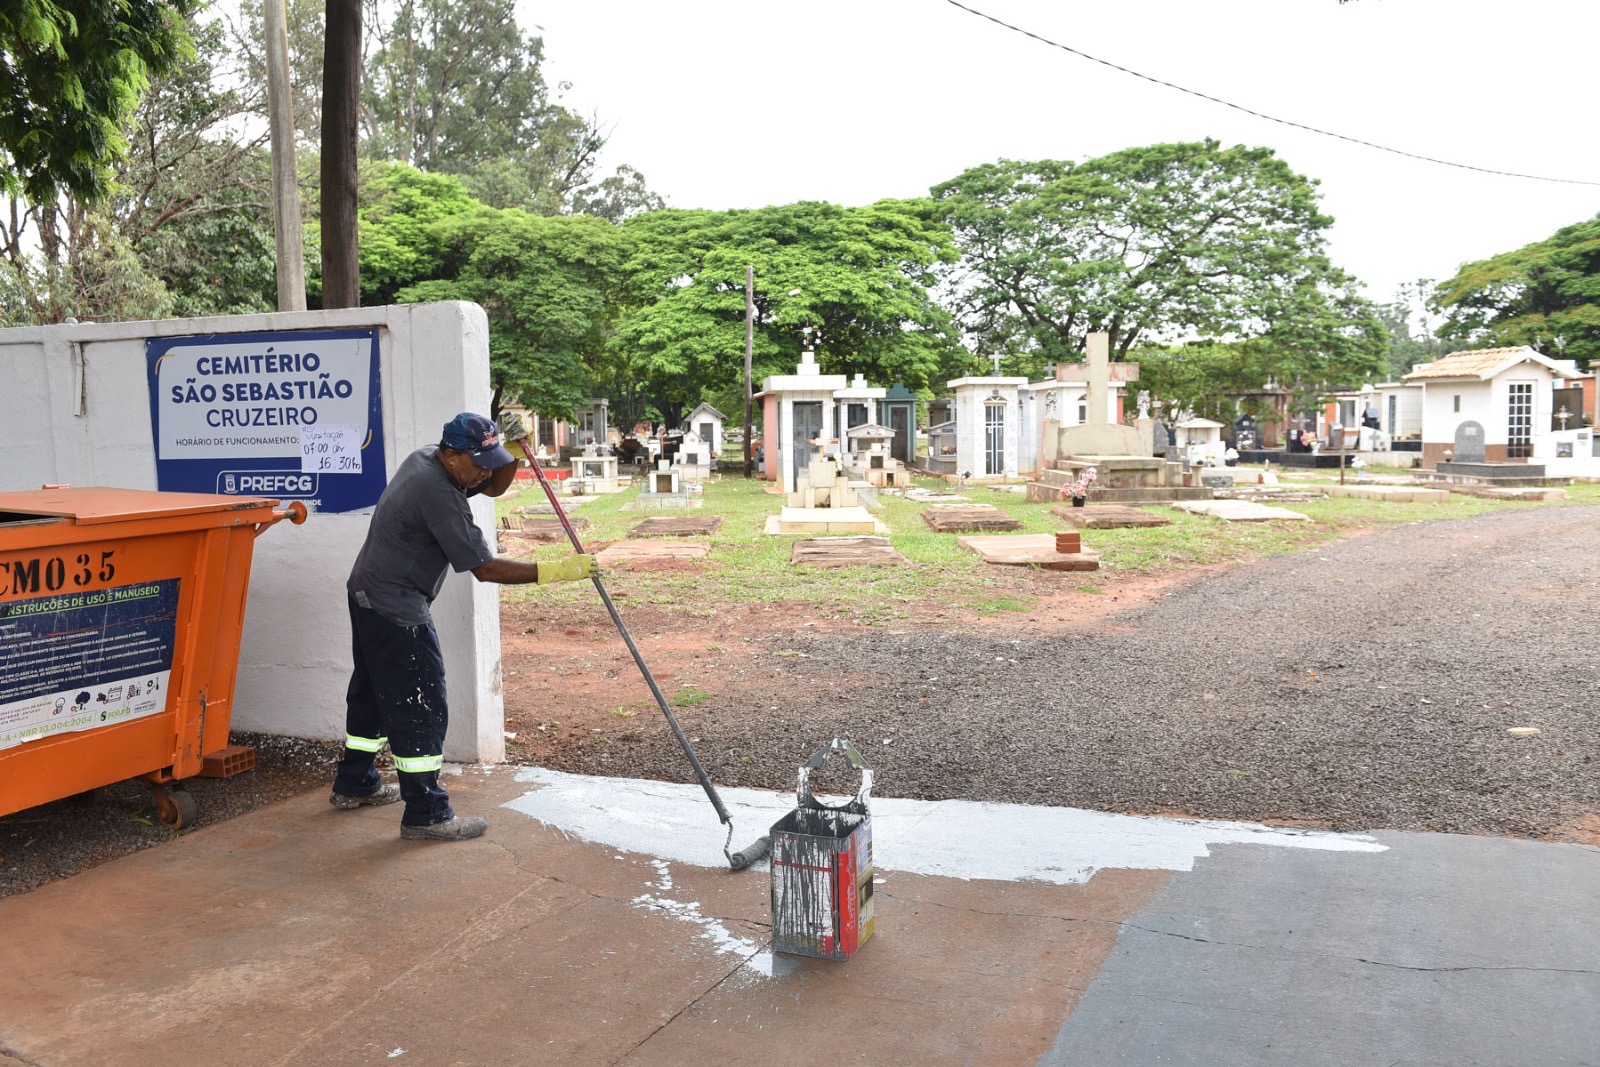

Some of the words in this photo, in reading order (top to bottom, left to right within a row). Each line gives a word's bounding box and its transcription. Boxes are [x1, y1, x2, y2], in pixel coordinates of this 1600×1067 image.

[196, 346, 320, 376] CEMITÉRIO
[171, 377, 217, 404] SÃO
[222, 372, 353, 402] SEBASTIÃO
[206, 406, 318, 427] CRUZEIRO
[176, 437, 212, 446] HORÁRIO
[213, 438, 224, 446] DE
[226, 436, 300, 445] FUNCIONAMENTO:
[303, 442, 329, 455] 07:00
[240, 475, 312, 492] PREFCG
[7, 598, 70, 615] NSTRUÇÕES
[71, 596, 84, 607] DE
[86, 593, 105, 605] USO
[107, 592, 113, 601] E
[114, 585, 160, 600] MANUSEIO
